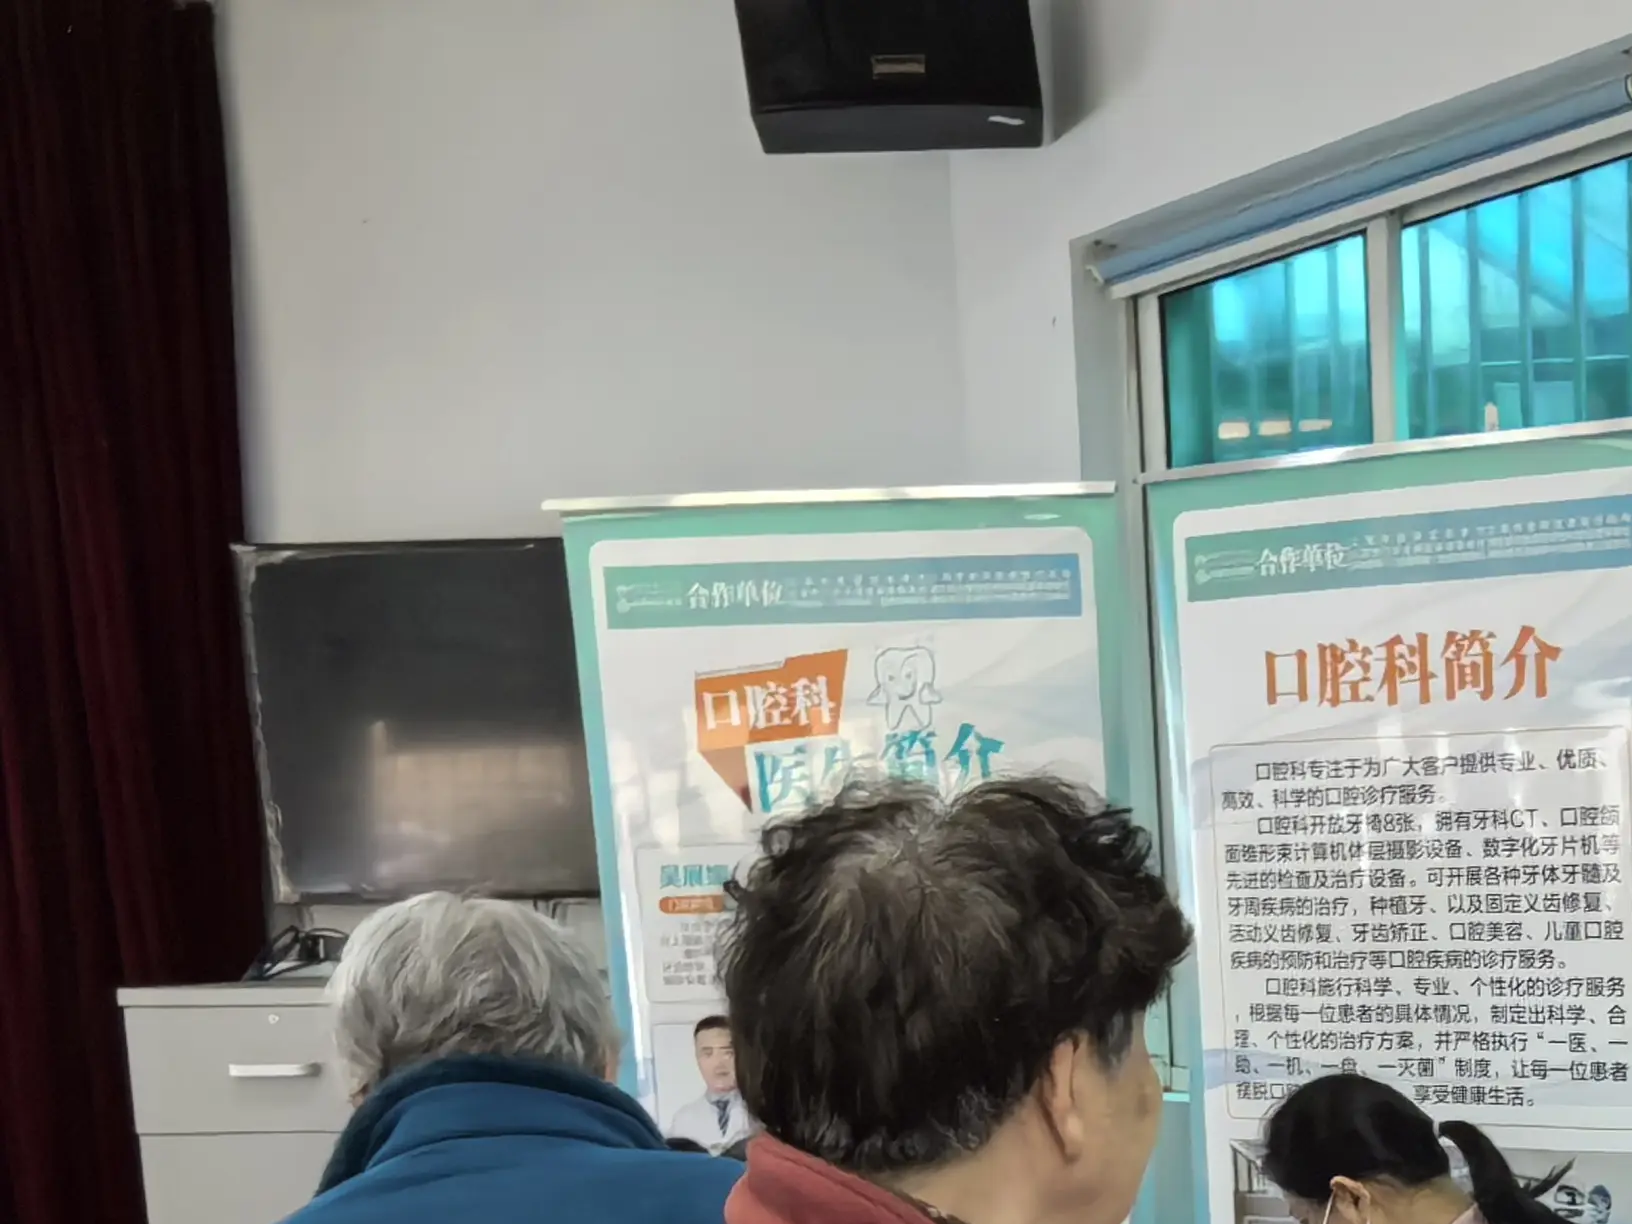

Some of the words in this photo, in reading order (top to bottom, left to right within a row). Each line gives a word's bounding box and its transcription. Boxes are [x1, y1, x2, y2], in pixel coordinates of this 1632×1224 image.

[1259, 542, 1350, 578] 合作单位
[686, 579, 784, 611] 合作单位
[1265, 625, 1562, 709] 口腔科简介
[702, 675, 836, 731] 口腔科
[753, 723, 1006, 813] 医简介
[1256, 748, 1608, 781] 口腔科专注于为广大客户提供专业、优质、
[1221, 784, 1446, 811] 高效、科学的口腔诊疗服务。
[1231, 949, 1566, 970] 疾病的预防和治疗等口腔疾病的诊疗服务。
[1413, 1084, 1535, 1107] 享受健康生活。
